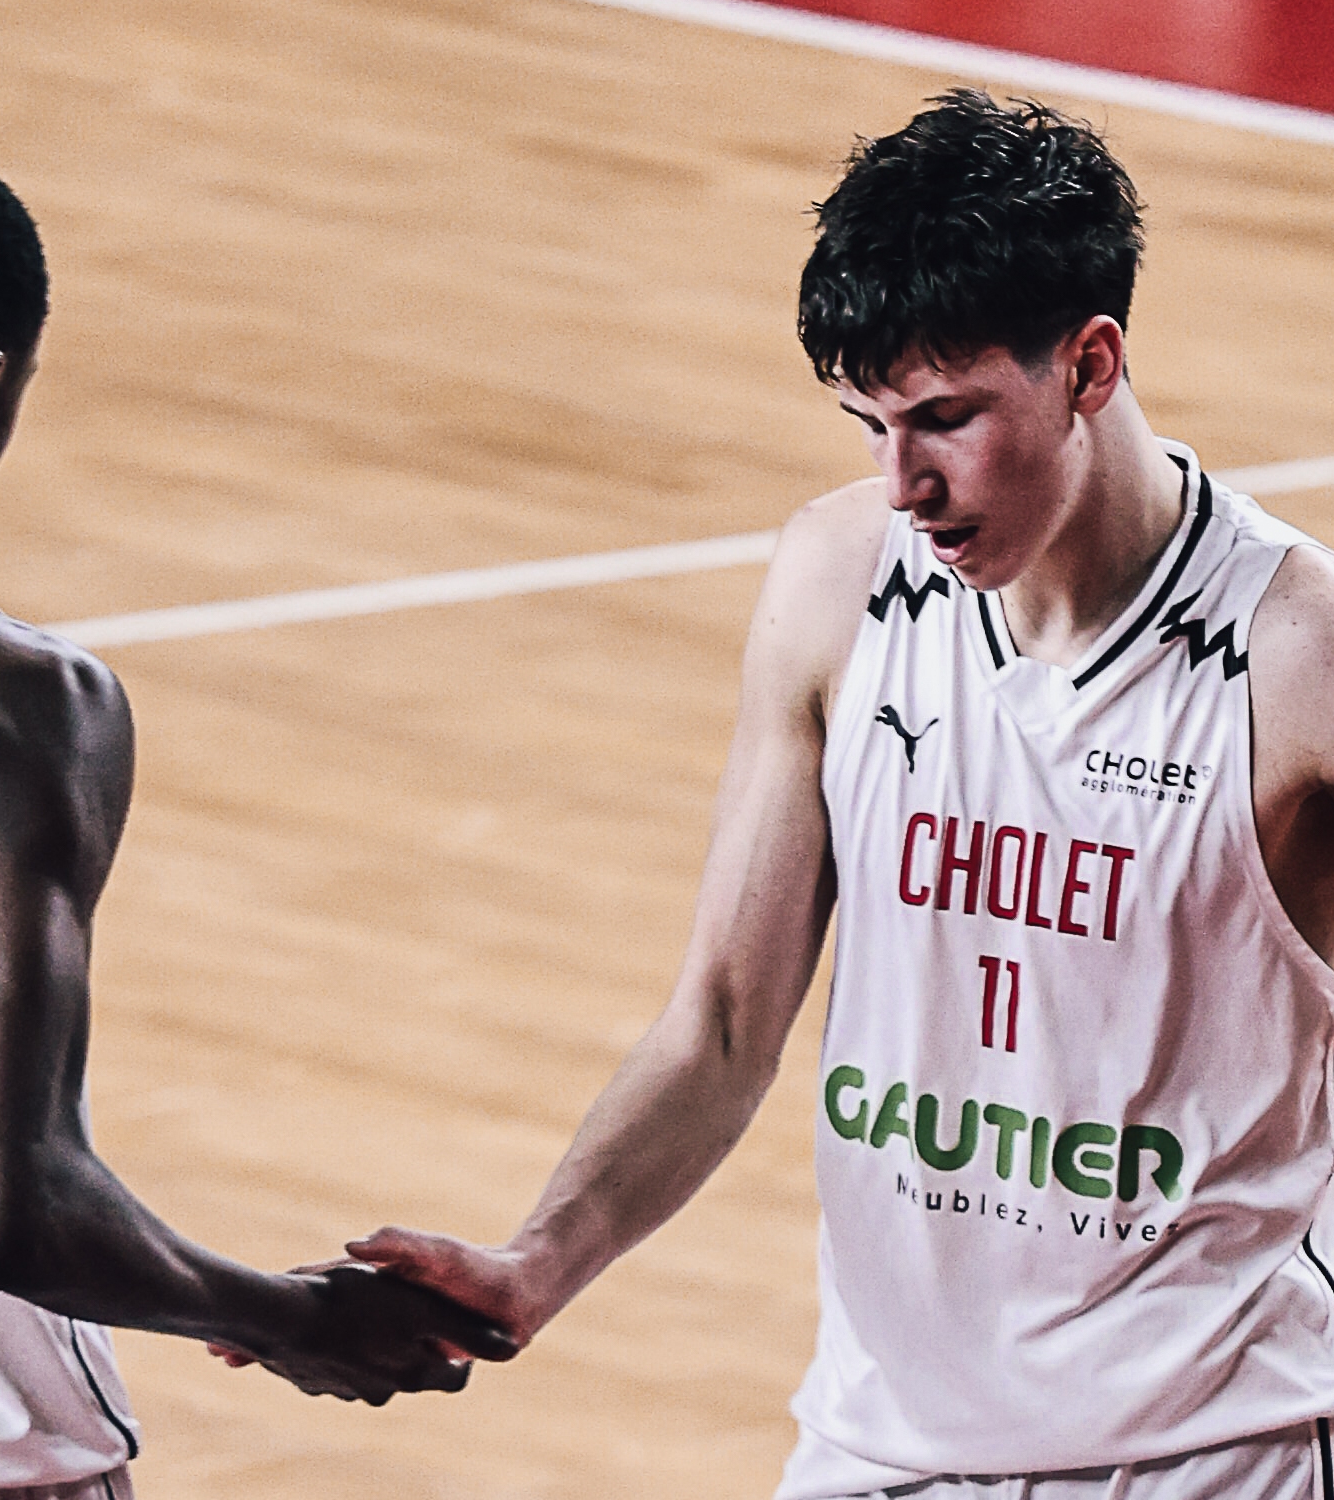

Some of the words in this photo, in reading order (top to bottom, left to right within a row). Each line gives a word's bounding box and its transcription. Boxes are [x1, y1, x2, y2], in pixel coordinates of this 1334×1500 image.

[899, 812, 1135, 941] CHOLET
[979, 954, 1021, 1053] 11
[824, 1064, 1184, 1203] GAUTIER
